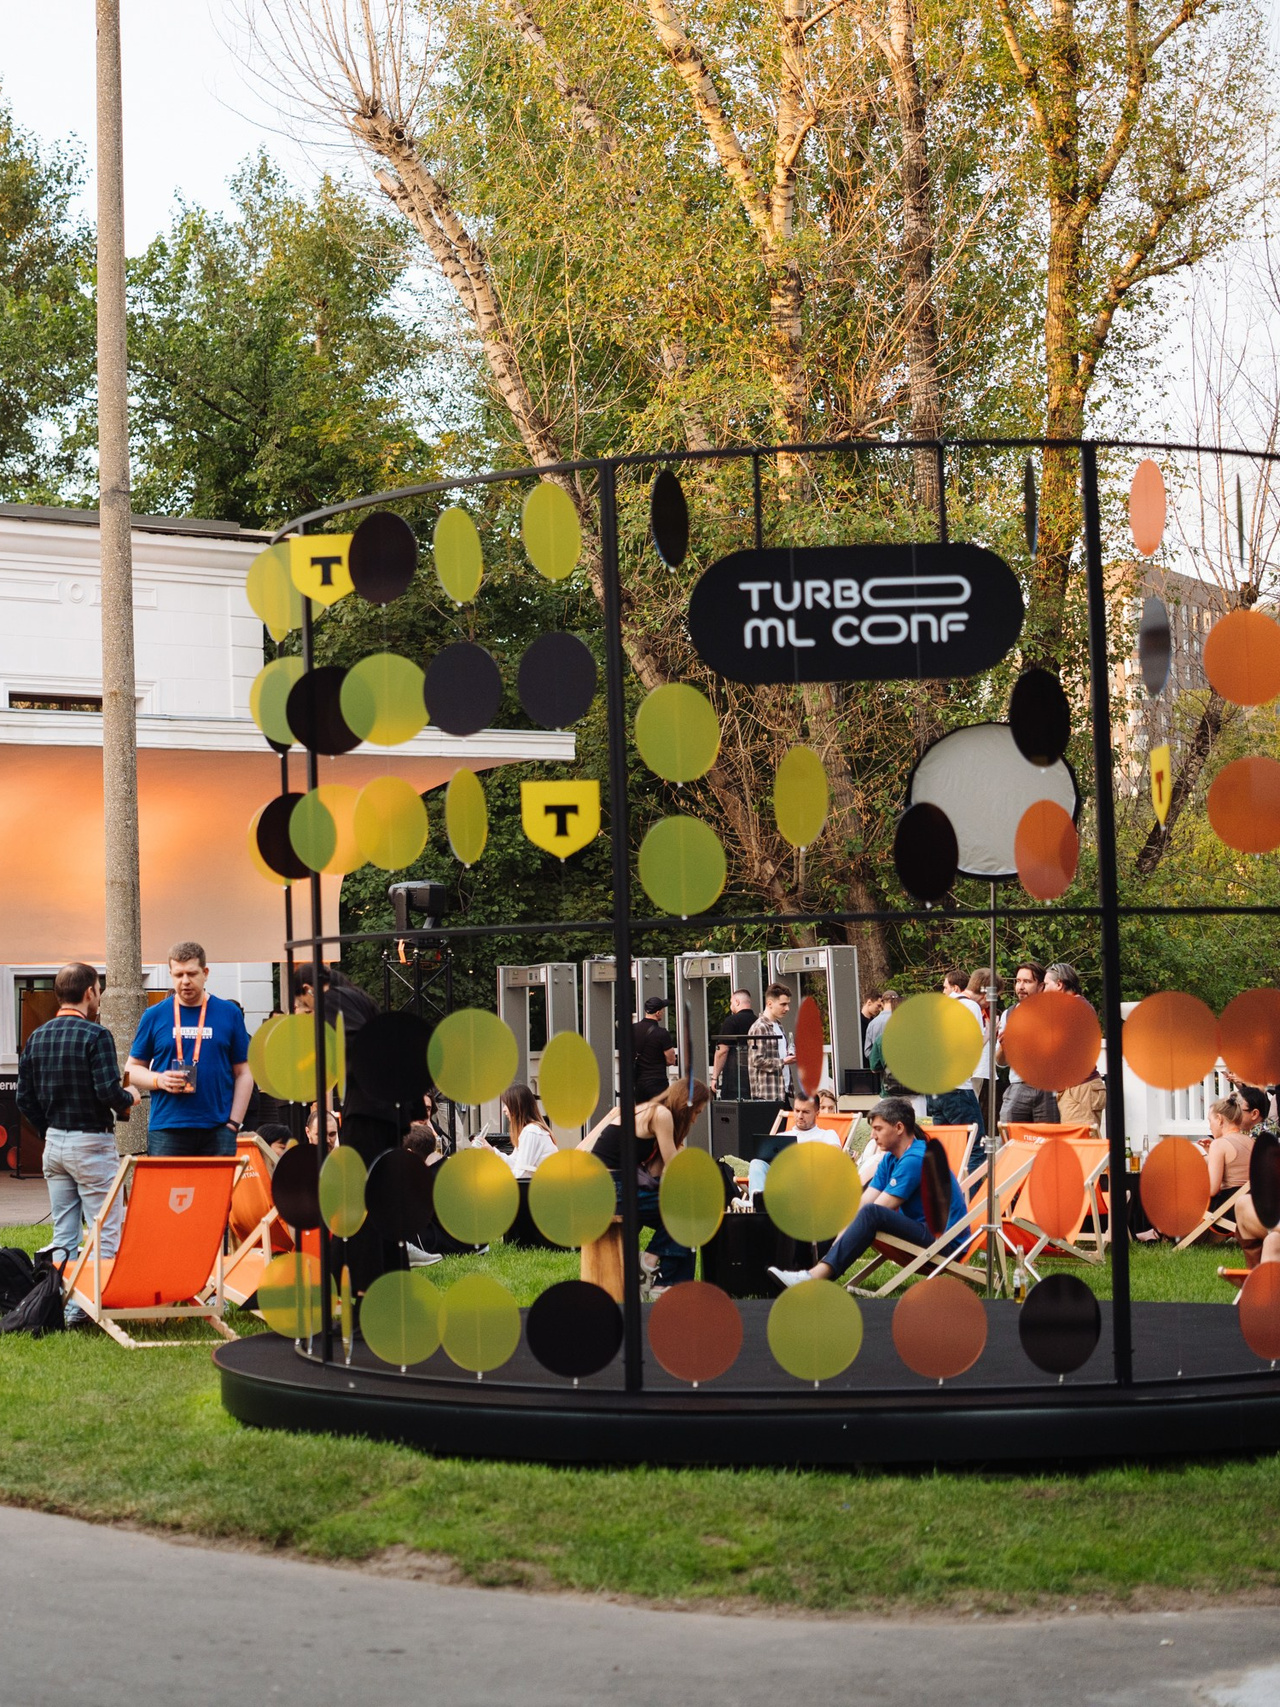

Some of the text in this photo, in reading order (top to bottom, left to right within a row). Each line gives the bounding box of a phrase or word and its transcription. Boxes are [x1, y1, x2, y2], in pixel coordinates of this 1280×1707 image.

[738, 575, 972, 611] TURBO
[744, 612, 969, 649] ML CONF
